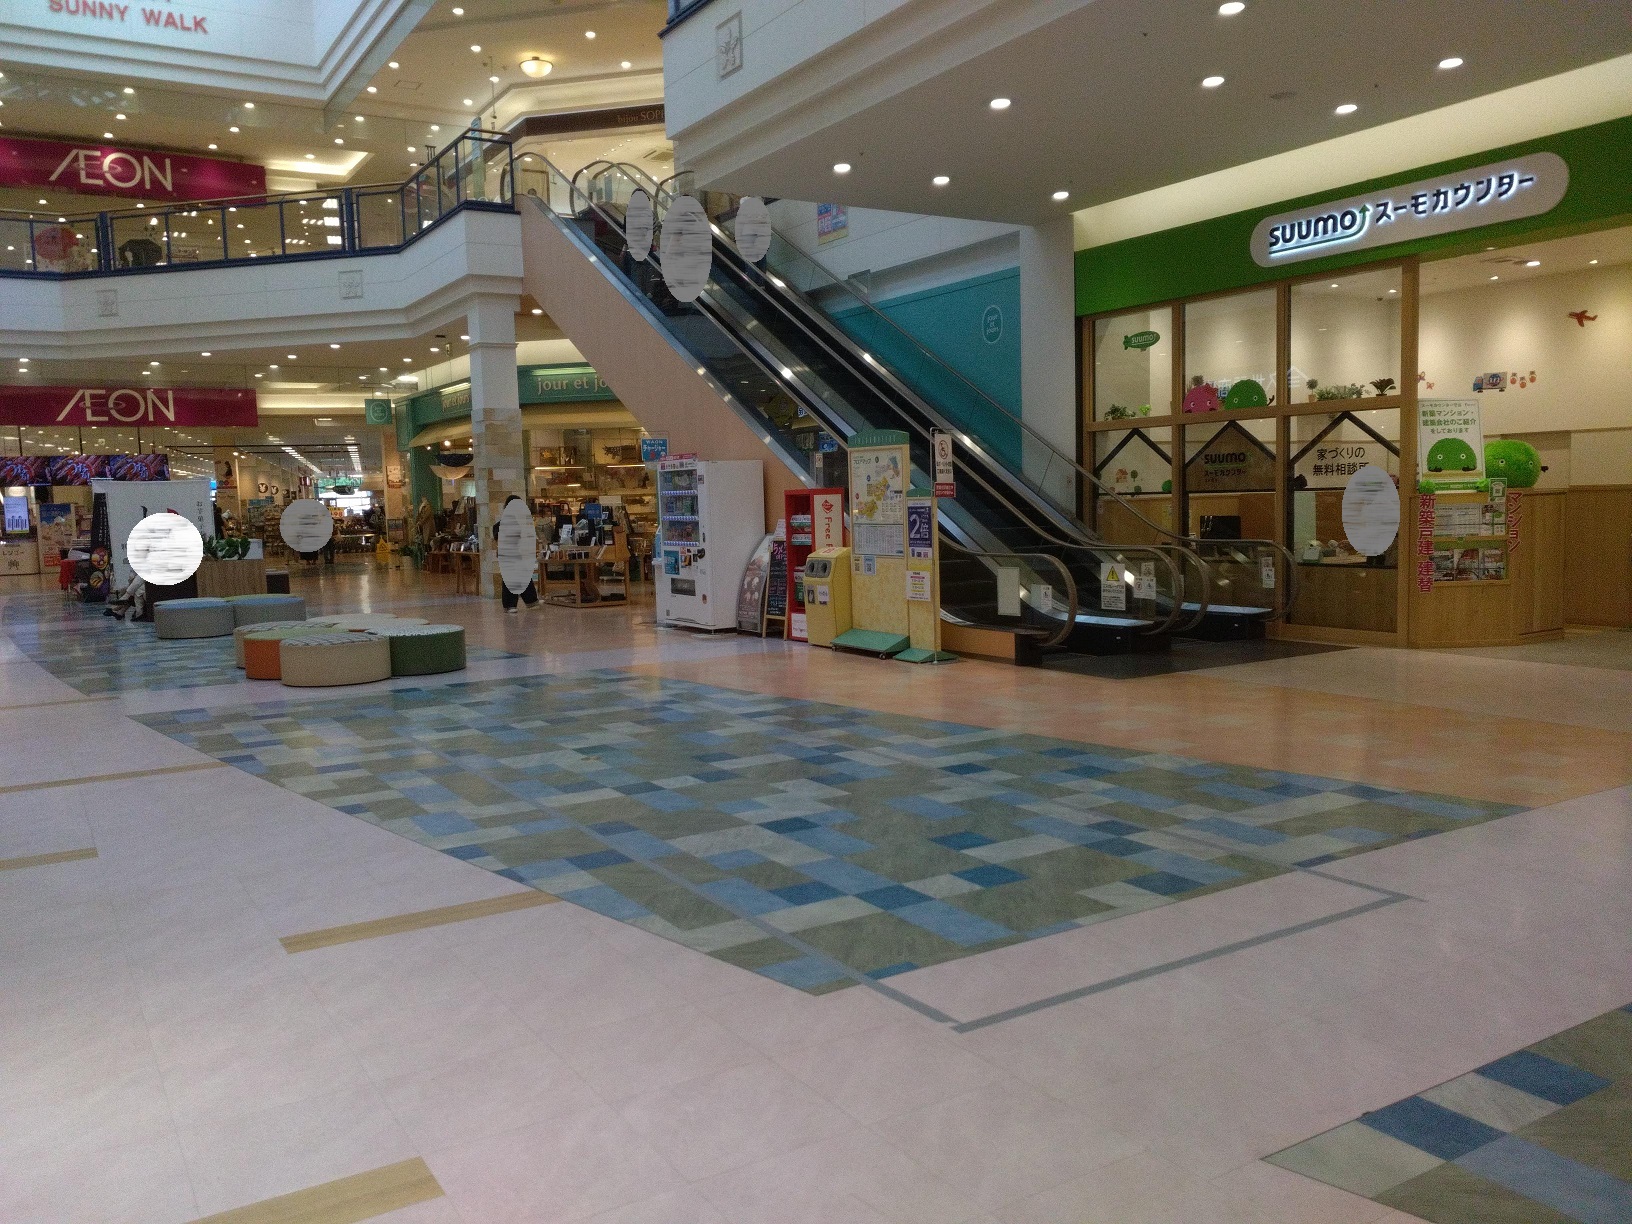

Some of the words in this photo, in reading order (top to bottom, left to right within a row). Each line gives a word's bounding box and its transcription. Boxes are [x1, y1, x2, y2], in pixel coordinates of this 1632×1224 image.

[49, 0, 129, 21] SUNNY
[141, 8, 208, 34] WALK
[1375, 172, 1534, 224] スーモカウンター
[537, 377, 568, 395] jour
[574, 376, 590, 389] et
[1316, 447, 1366, 461] 家づくりの
[824, 517, 833, 539] Free
[1507, 491, 1523, 553] マンション
